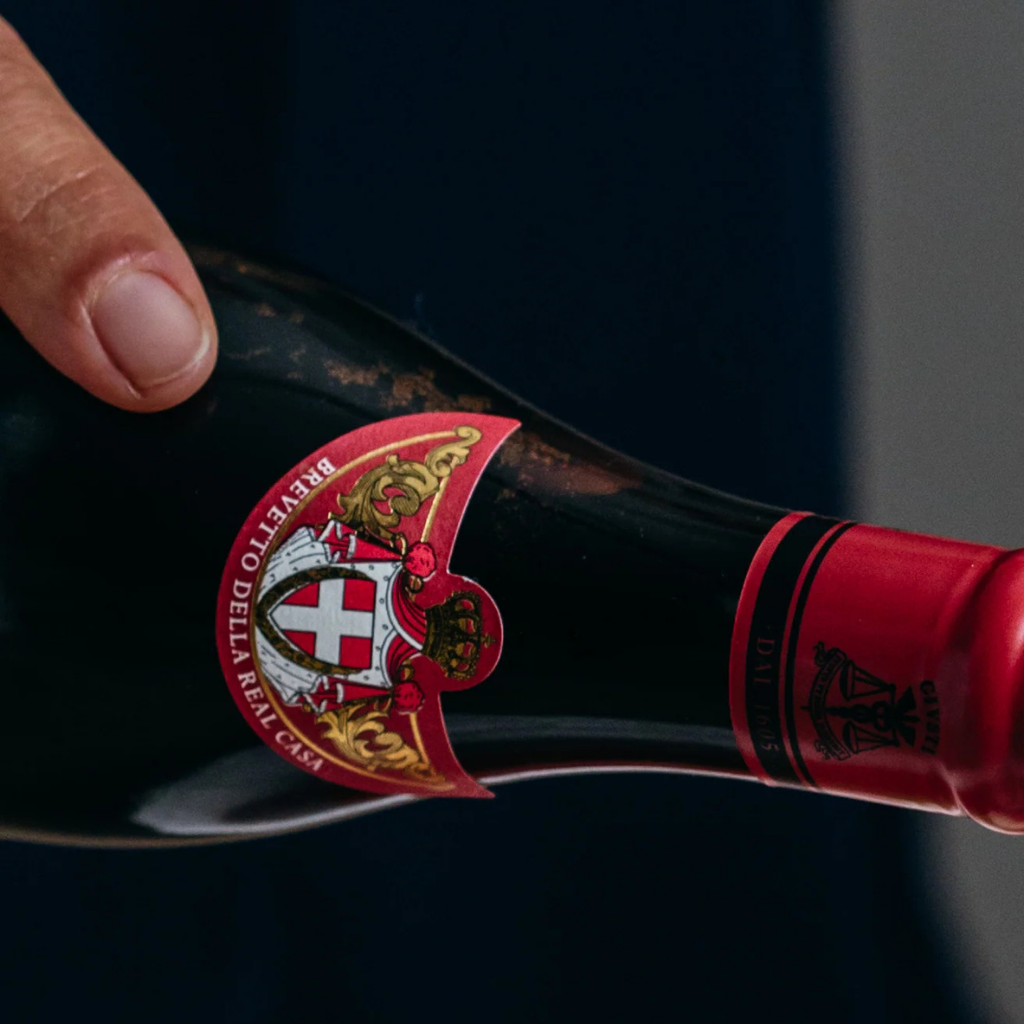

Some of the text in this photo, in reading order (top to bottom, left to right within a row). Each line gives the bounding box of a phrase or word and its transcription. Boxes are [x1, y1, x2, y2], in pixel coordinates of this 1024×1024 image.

[229, 457, 337, 772] BREVETTO DELLA REAL CASA
[754, 636, 780, 752] DAL 1605
